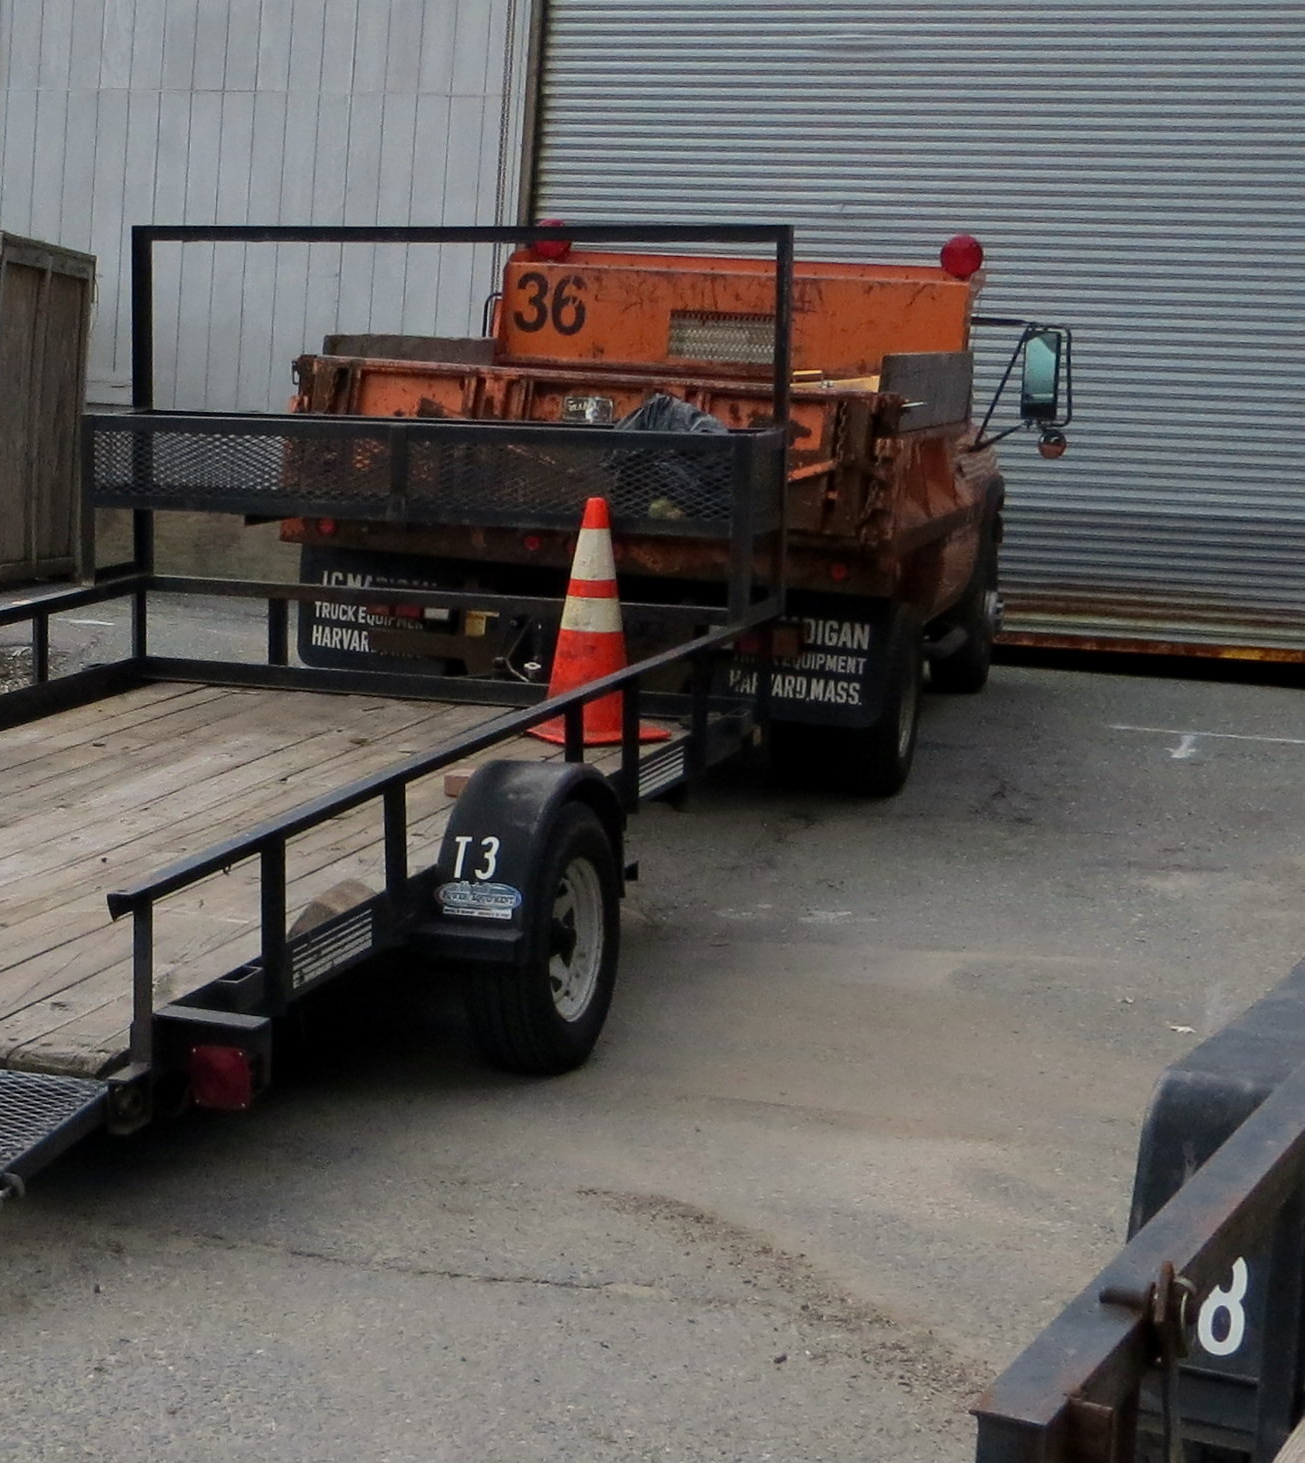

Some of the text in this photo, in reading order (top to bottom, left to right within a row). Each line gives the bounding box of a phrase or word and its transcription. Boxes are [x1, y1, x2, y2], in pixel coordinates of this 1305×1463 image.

[514, 272, 586, 335] 36
[315, 601, 357, 622] TRUCK
[311, 624, 378, 653] HARVAR
